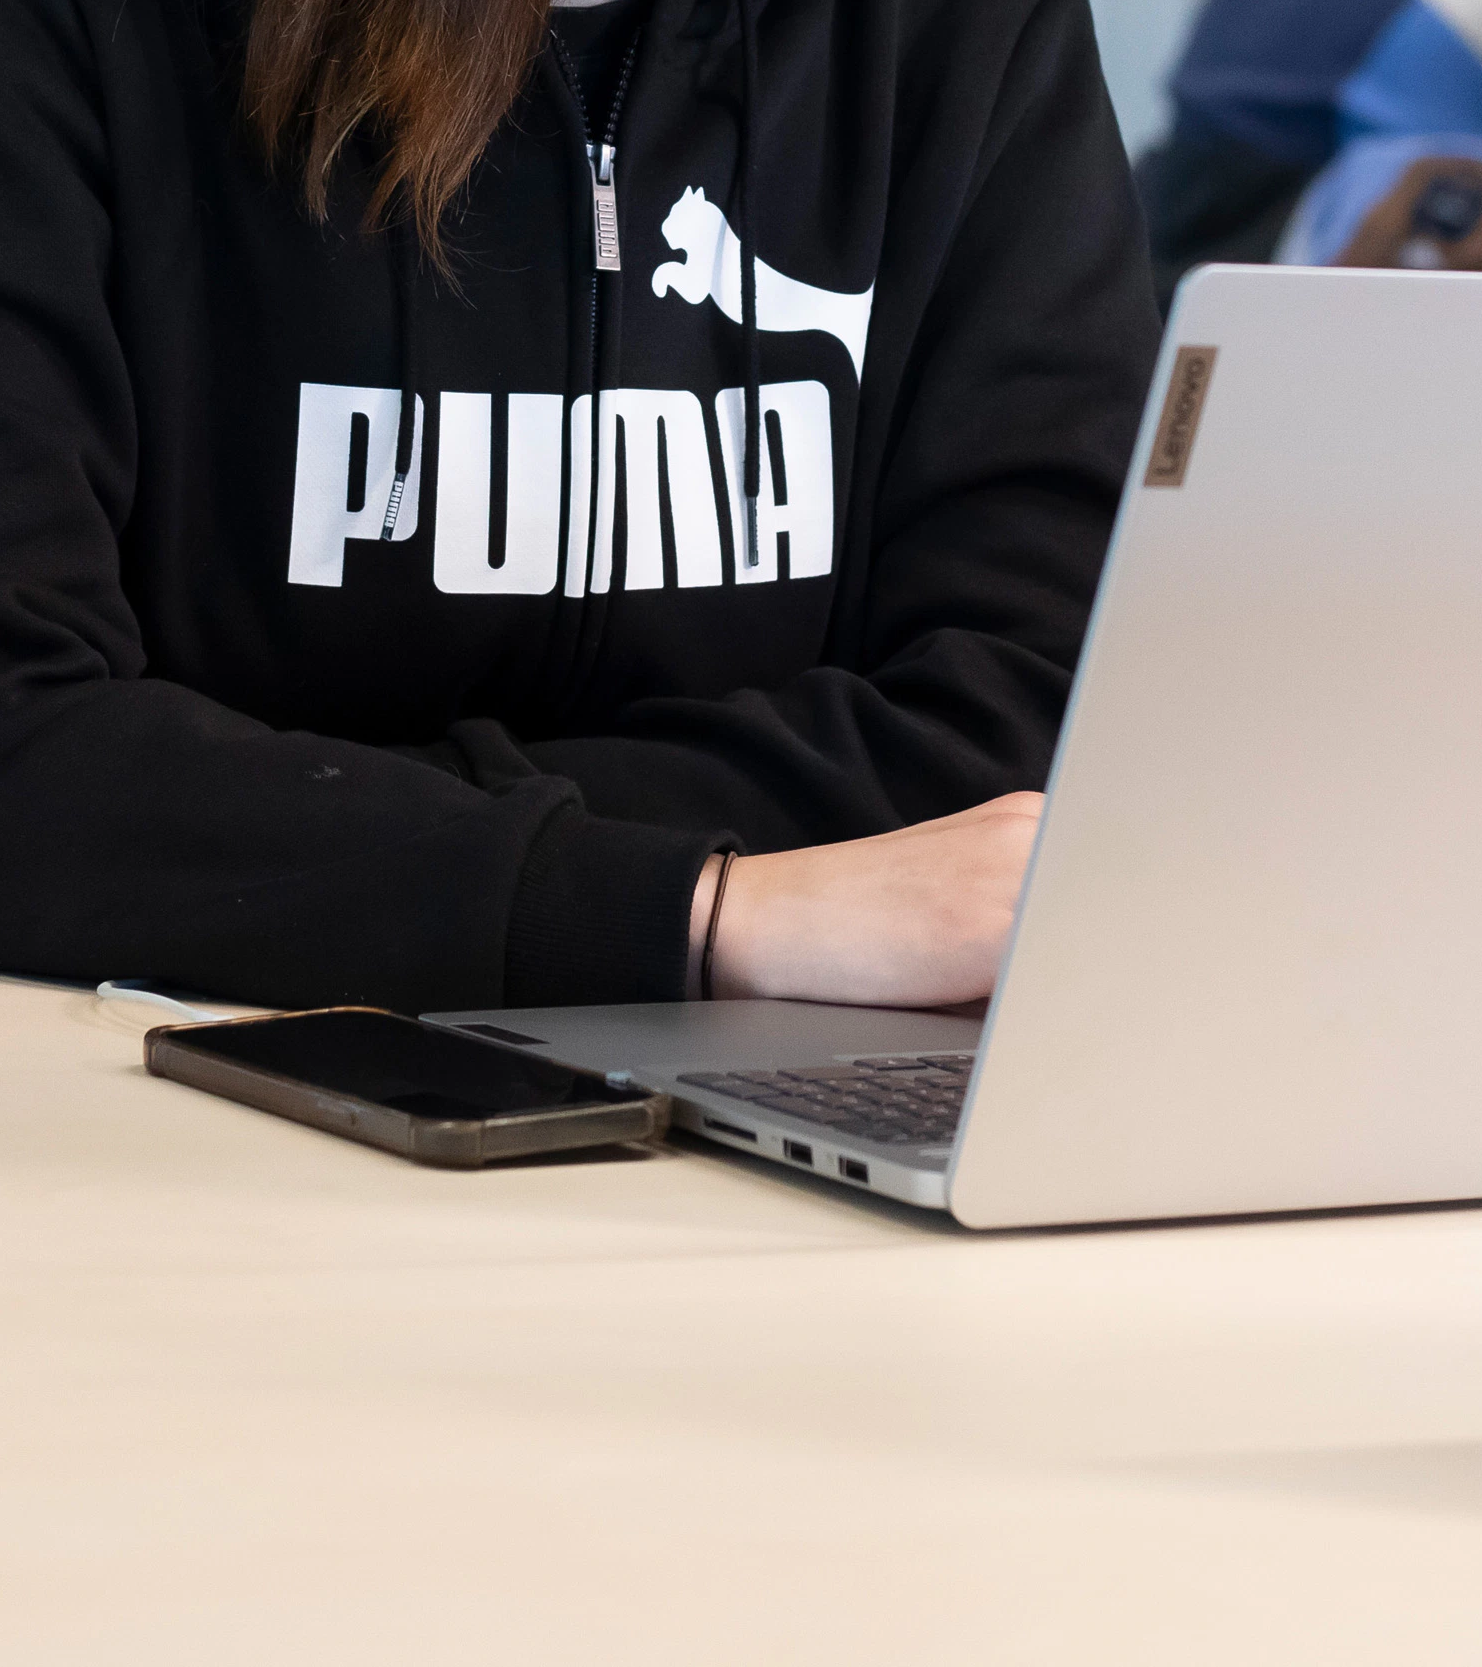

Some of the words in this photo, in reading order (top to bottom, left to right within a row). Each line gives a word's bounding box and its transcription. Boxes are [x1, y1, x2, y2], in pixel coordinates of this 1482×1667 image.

[596, 199, 618, 259] PUMA
[1152, 356, 1207, 477] Lenovo
[288, 380, 833, 598] PUMA
[384, 480, 404, 528] PUMA
